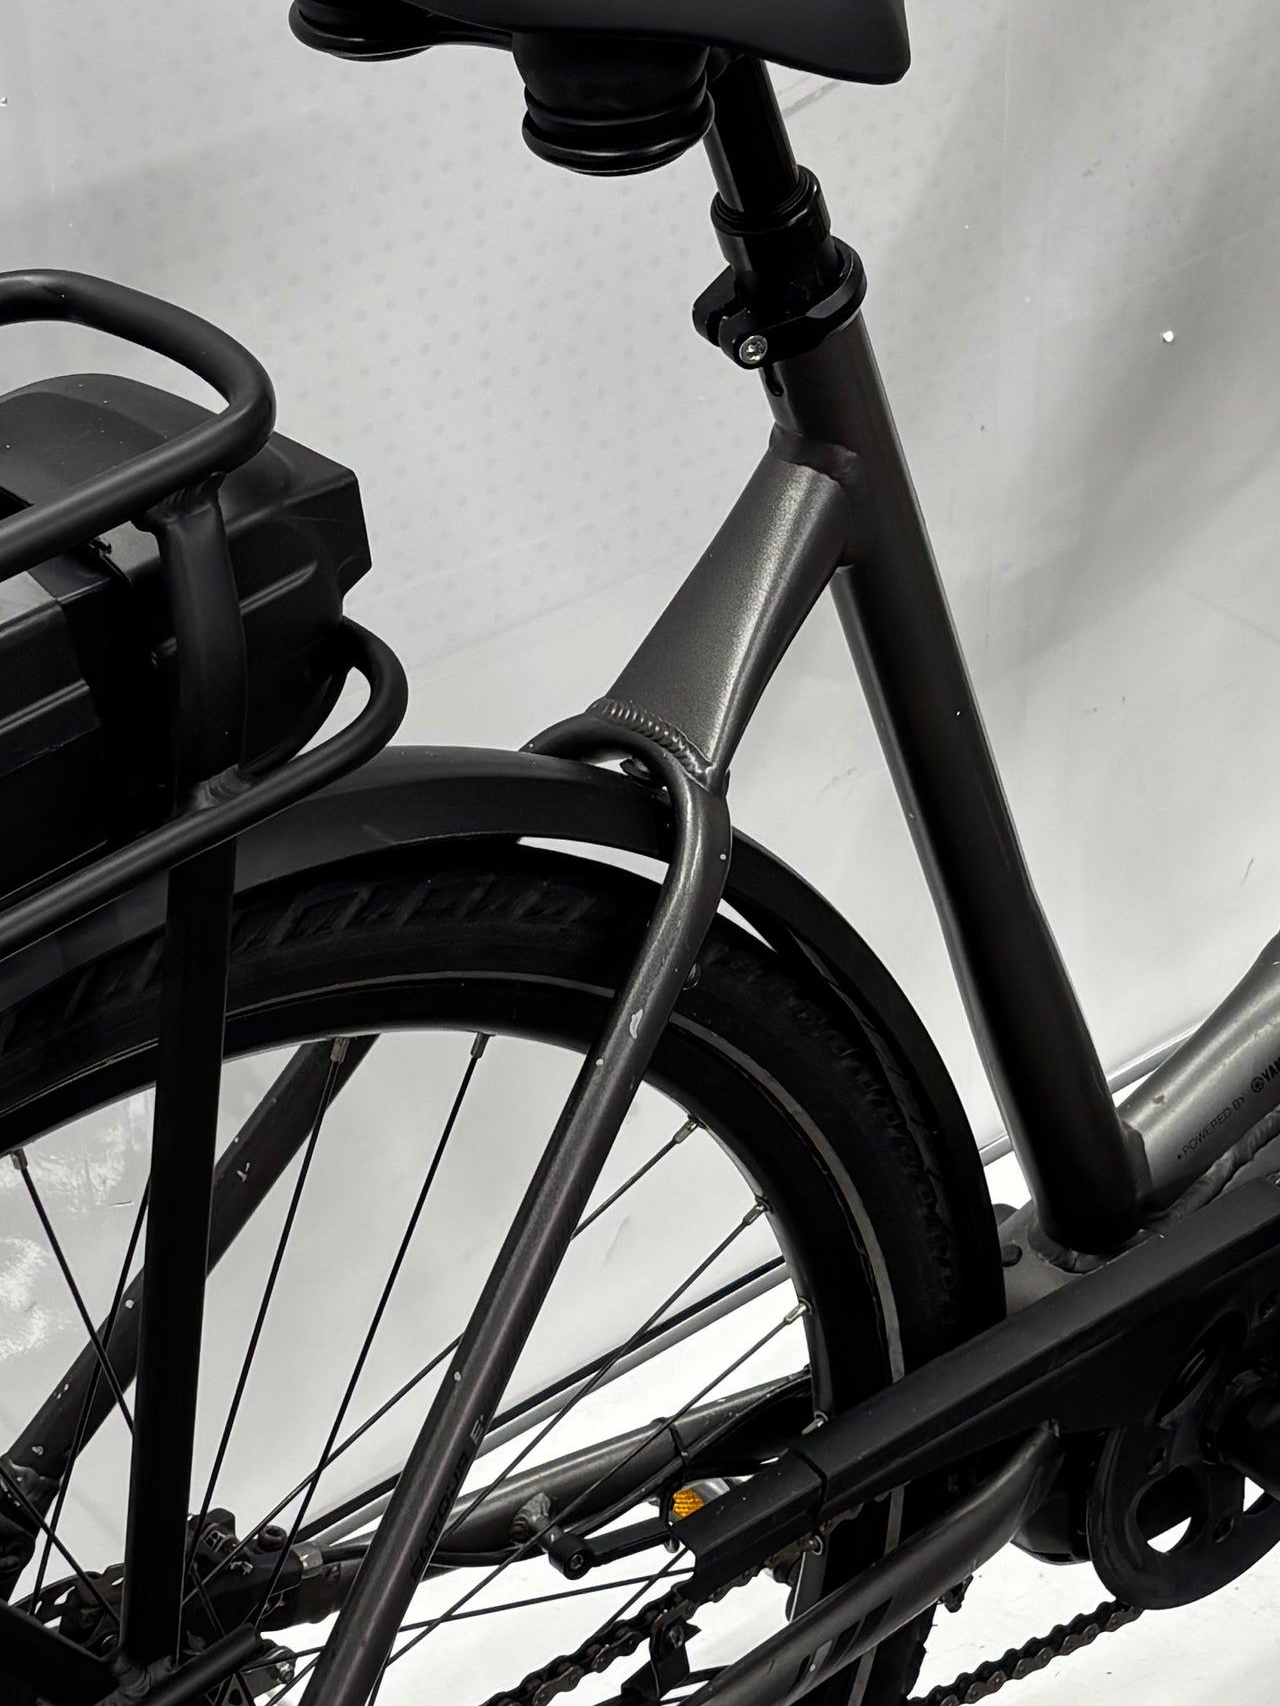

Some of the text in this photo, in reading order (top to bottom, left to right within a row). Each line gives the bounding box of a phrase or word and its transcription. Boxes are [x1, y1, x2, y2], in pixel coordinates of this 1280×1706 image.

[1181, 1106, 1233, 1154] POWERED
[1231, 1095, 1246, 1111] BY
[411, 1450, 470, 1569] ENTOUR
